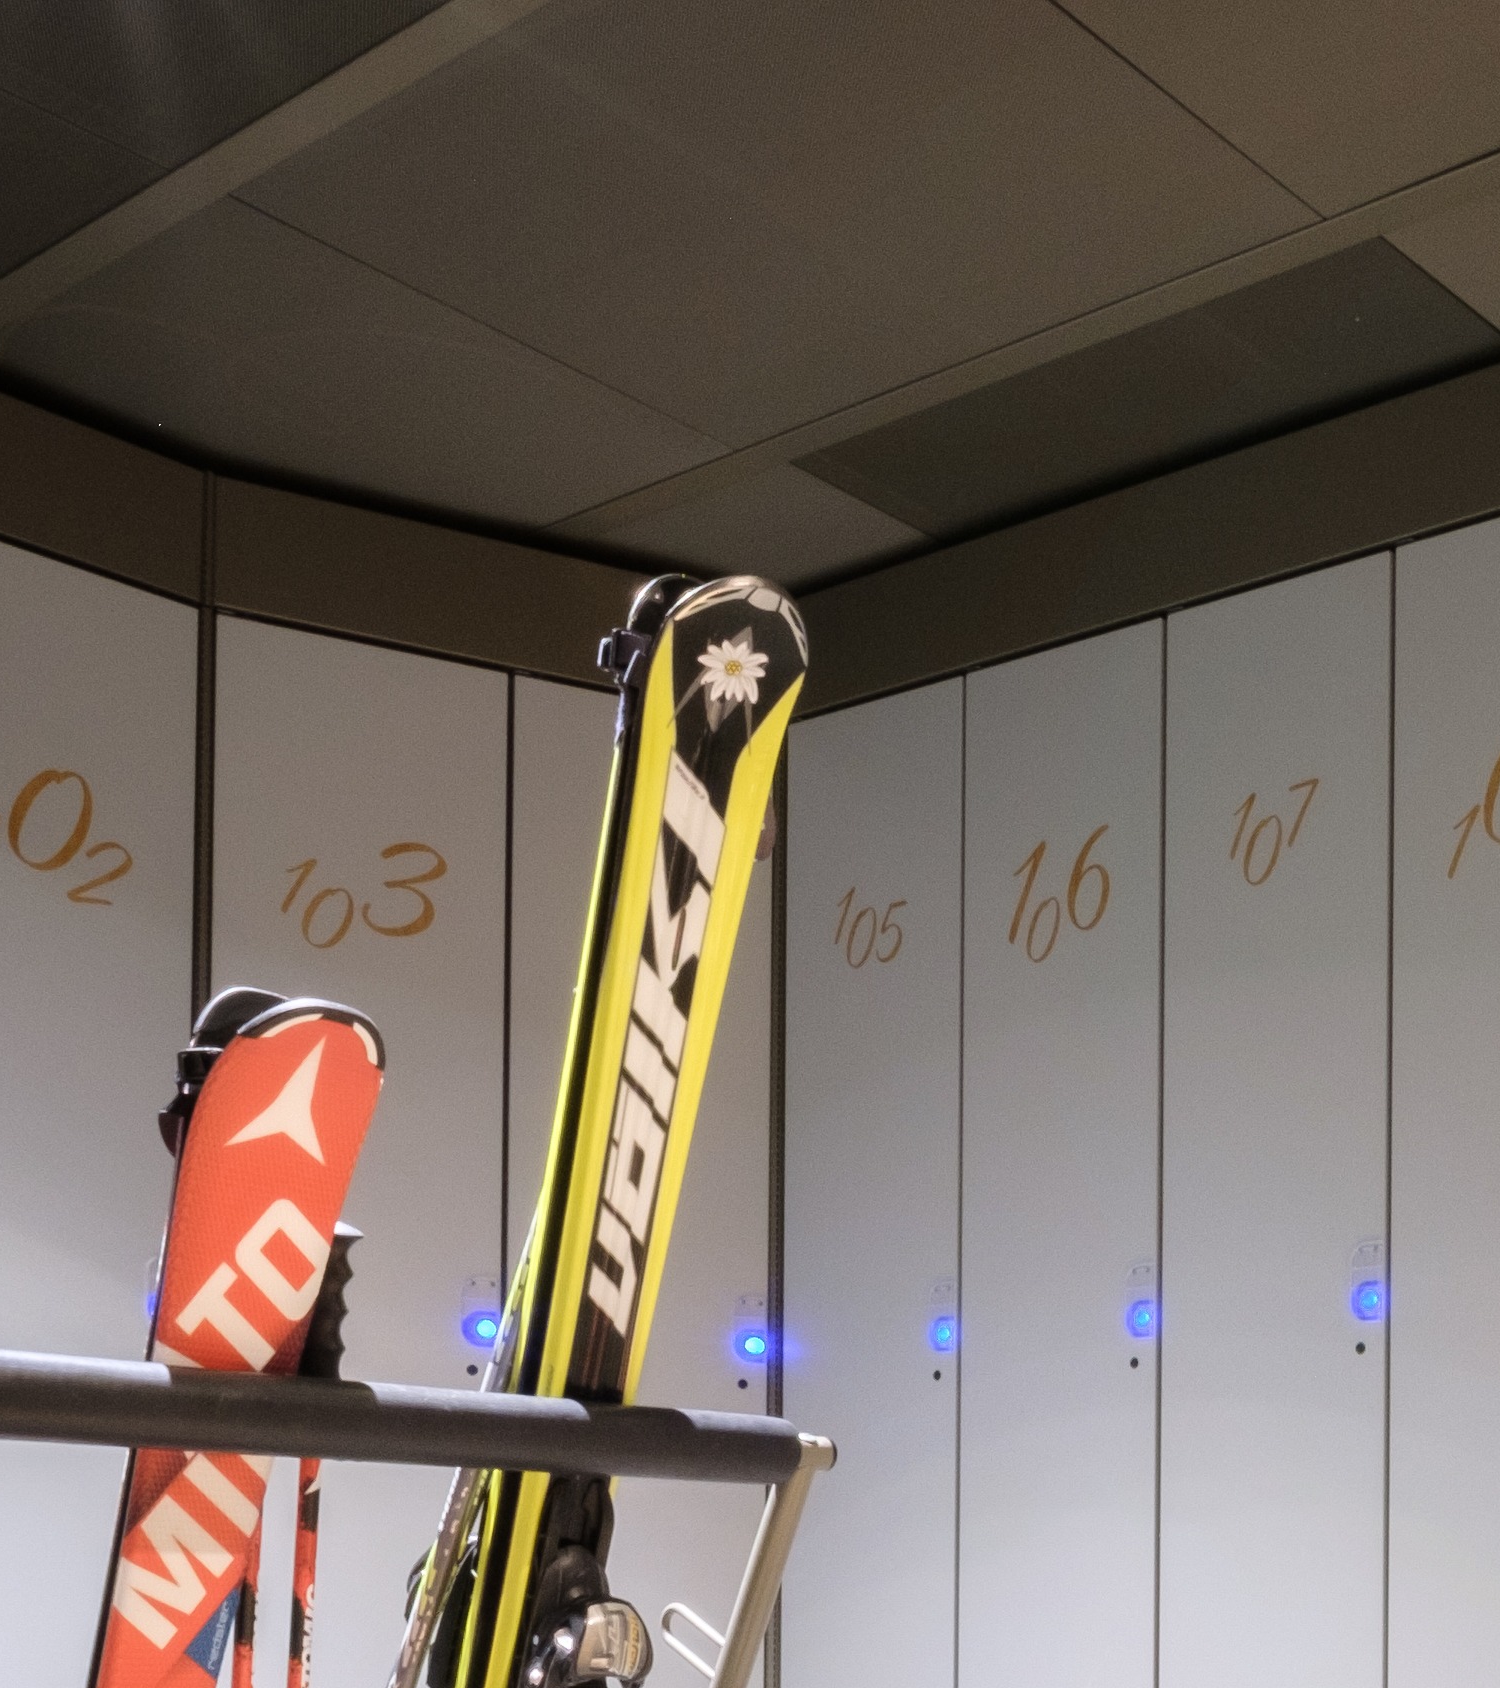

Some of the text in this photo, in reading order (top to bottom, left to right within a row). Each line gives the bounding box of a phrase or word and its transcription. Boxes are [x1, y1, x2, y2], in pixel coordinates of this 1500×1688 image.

[1229, 778, 1320, 886] 107
[281, 842, 448, 949] 103
[833, 886, 908, 970] 105
[1008, 824, 1111, 963] 106
